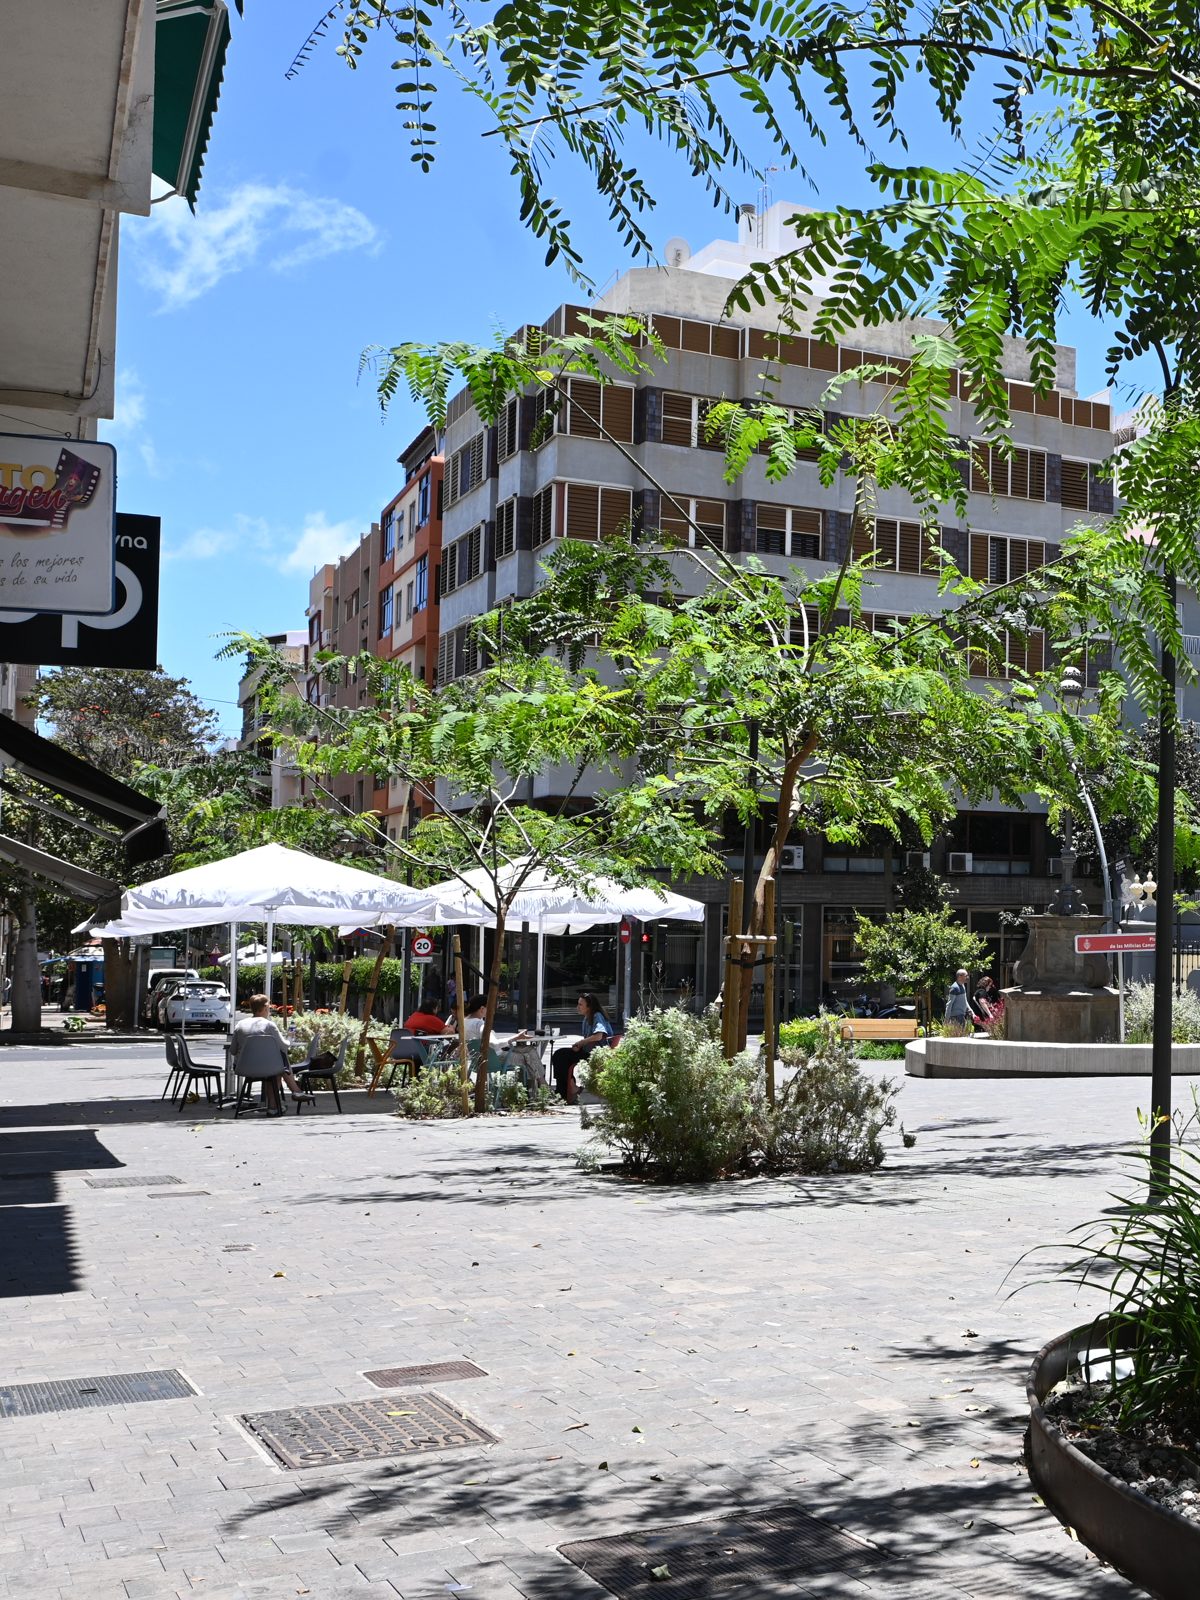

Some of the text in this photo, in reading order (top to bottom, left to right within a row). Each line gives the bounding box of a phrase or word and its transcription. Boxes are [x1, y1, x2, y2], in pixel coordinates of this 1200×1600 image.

[115, 534, 147, 549] na
[11, 552, 29, 567] los
[35, 554, 84, 573] mejores
[12, 570, 27, 586] de
[33, 575, 48, 584] su
[54, 570, 78, 583] vida
[416, 942, 429, 950] 20
